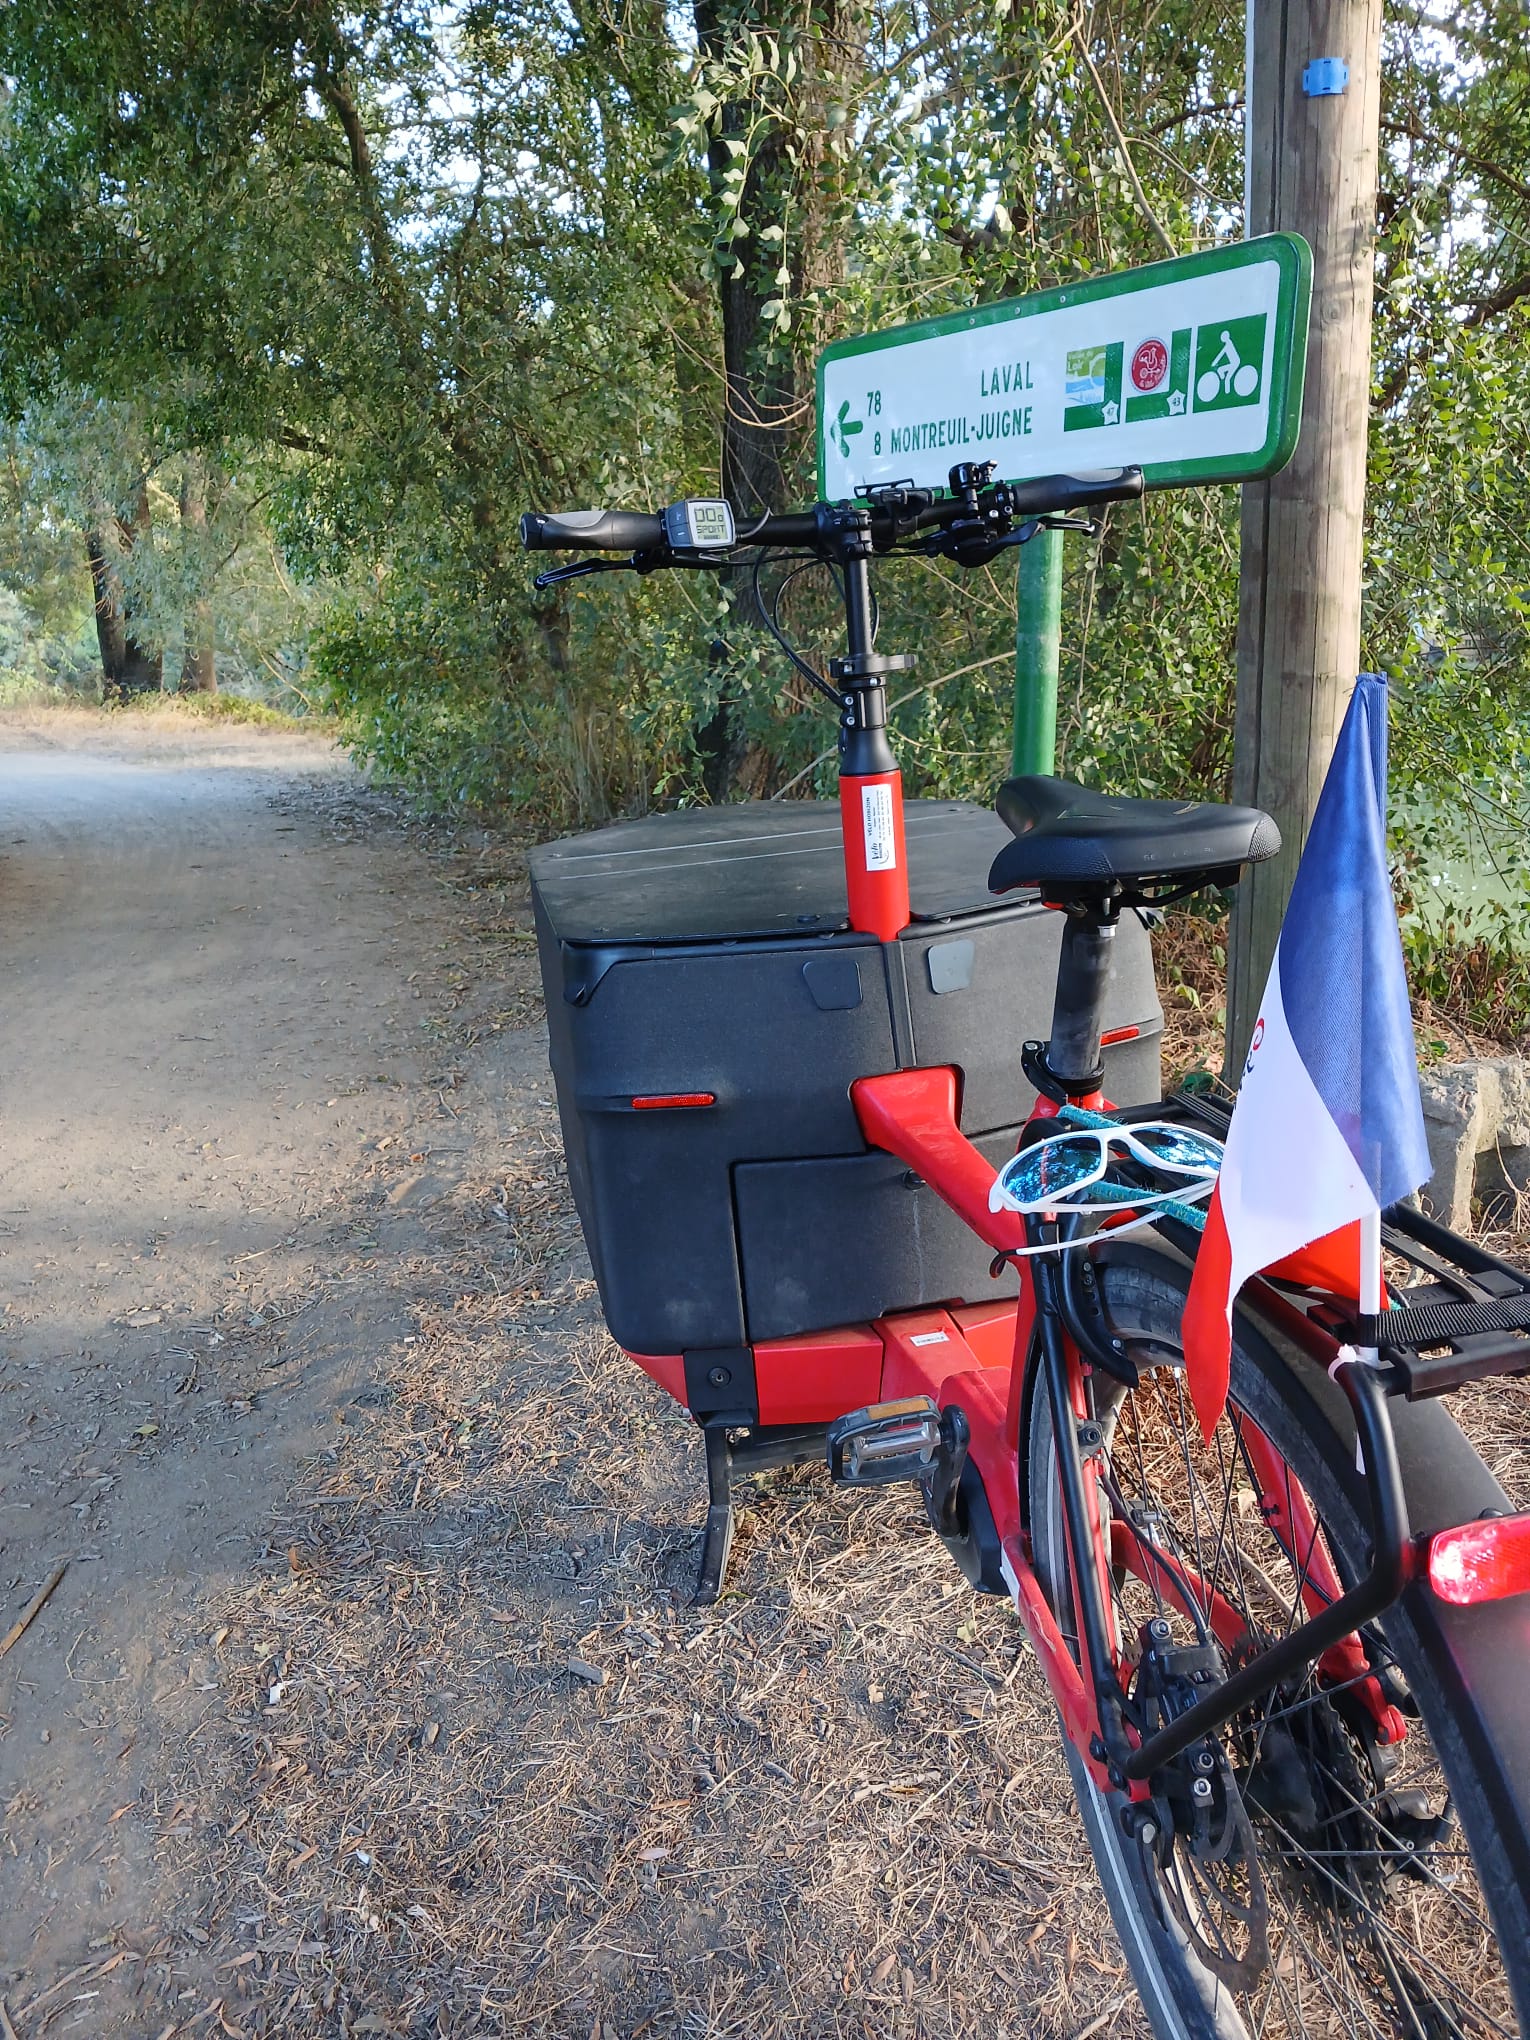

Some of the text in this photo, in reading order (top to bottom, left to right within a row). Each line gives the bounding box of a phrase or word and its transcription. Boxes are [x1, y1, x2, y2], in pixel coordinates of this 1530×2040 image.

[867, 361, 1033, 416] 78 LAVAL
[874, 406, 1033, 456] 8 MONTREUIL-JUIGNE
